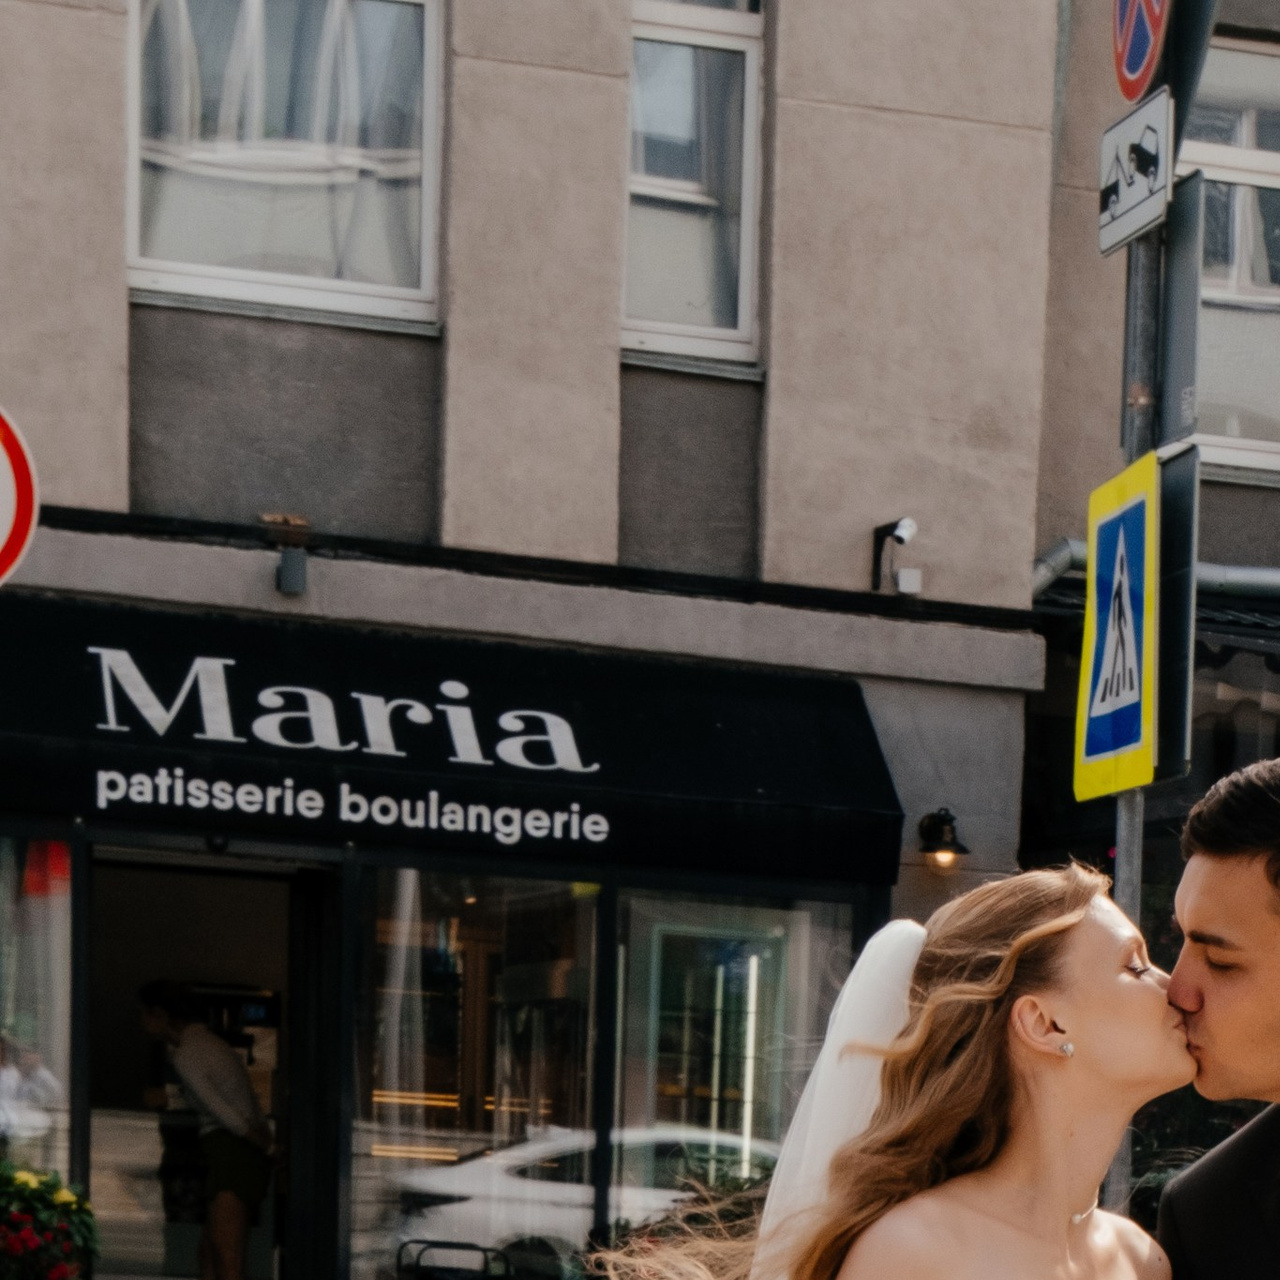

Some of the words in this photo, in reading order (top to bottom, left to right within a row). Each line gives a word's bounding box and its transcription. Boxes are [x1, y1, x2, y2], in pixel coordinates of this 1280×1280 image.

[87, 647, 600, 773] Maria
[96, 767, 325, 819] patisserie
[339, 783, 610, 845] boulangerie
